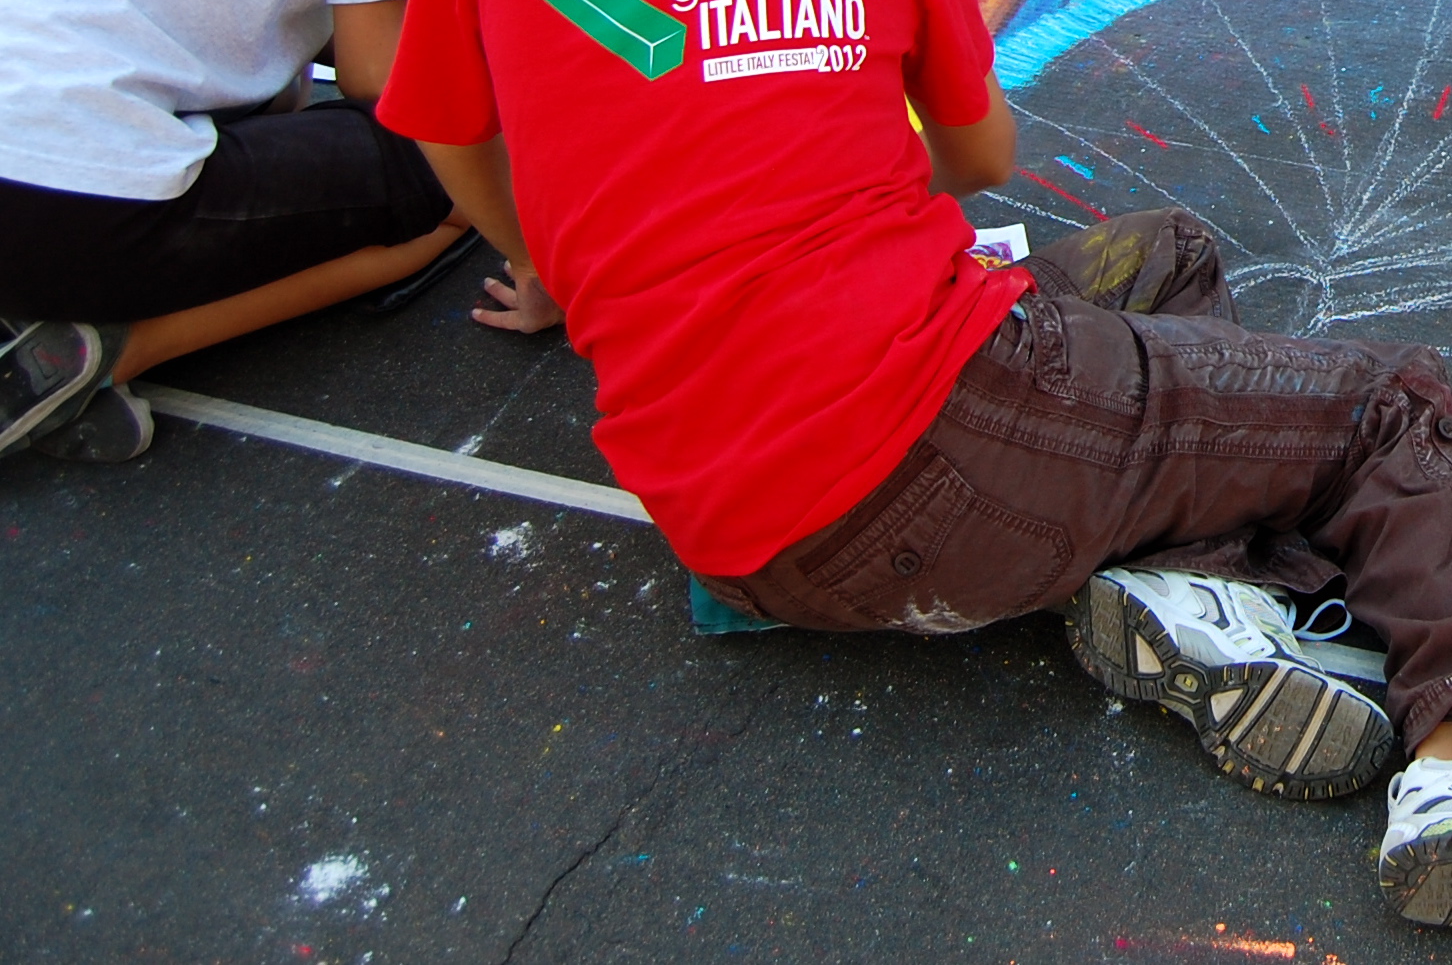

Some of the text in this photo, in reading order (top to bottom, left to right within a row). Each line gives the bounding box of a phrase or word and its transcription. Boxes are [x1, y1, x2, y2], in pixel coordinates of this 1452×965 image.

[707, 44, 867, 76] LITTLE ITALY FESTA! 2012
